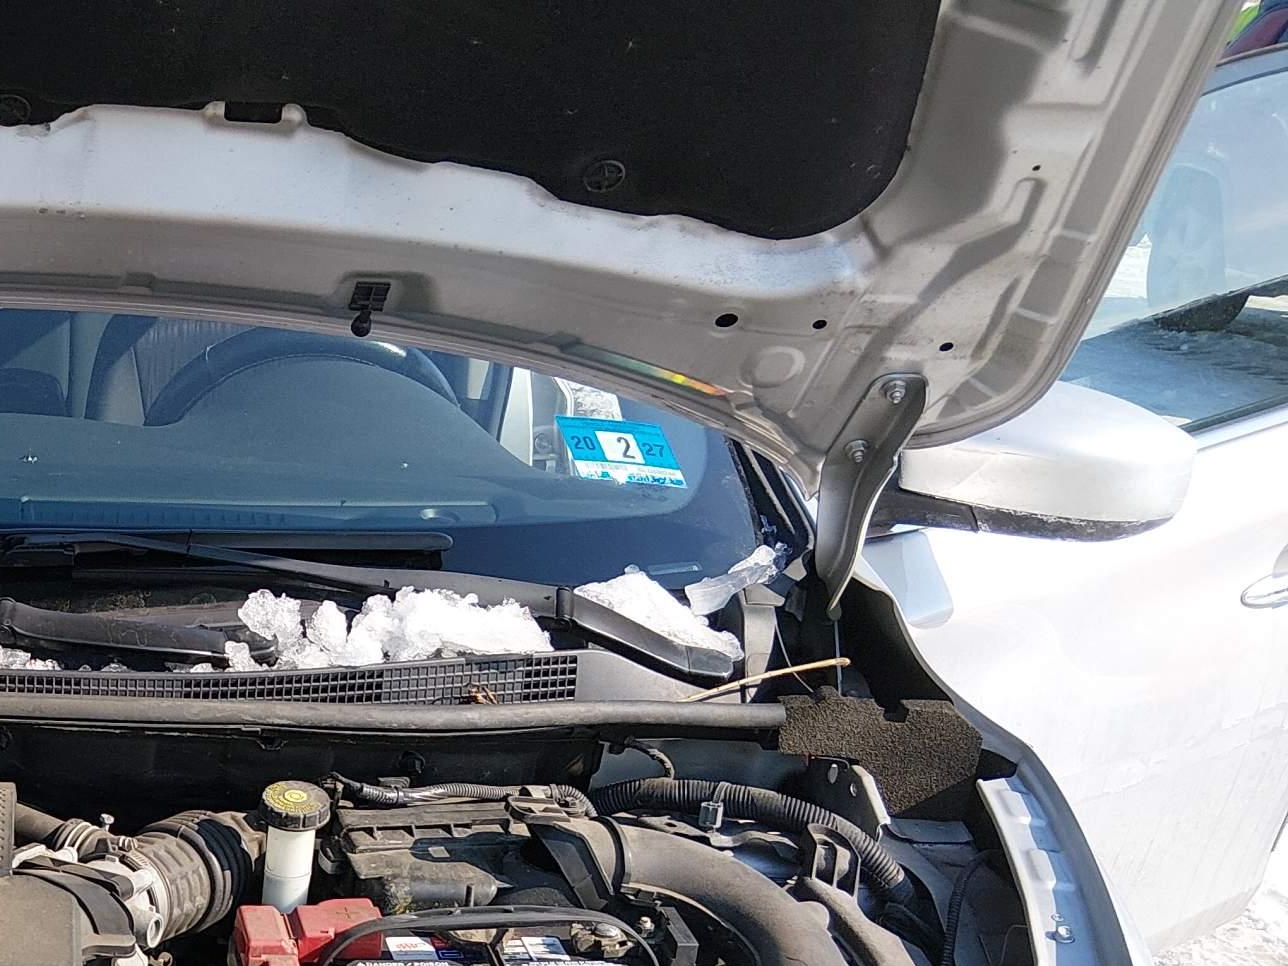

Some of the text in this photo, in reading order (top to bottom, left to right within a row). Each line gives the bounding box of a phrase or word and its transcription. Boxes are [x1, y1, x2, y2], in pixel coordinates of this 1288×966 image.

[570, 435, 665, 460] 20 2 27
